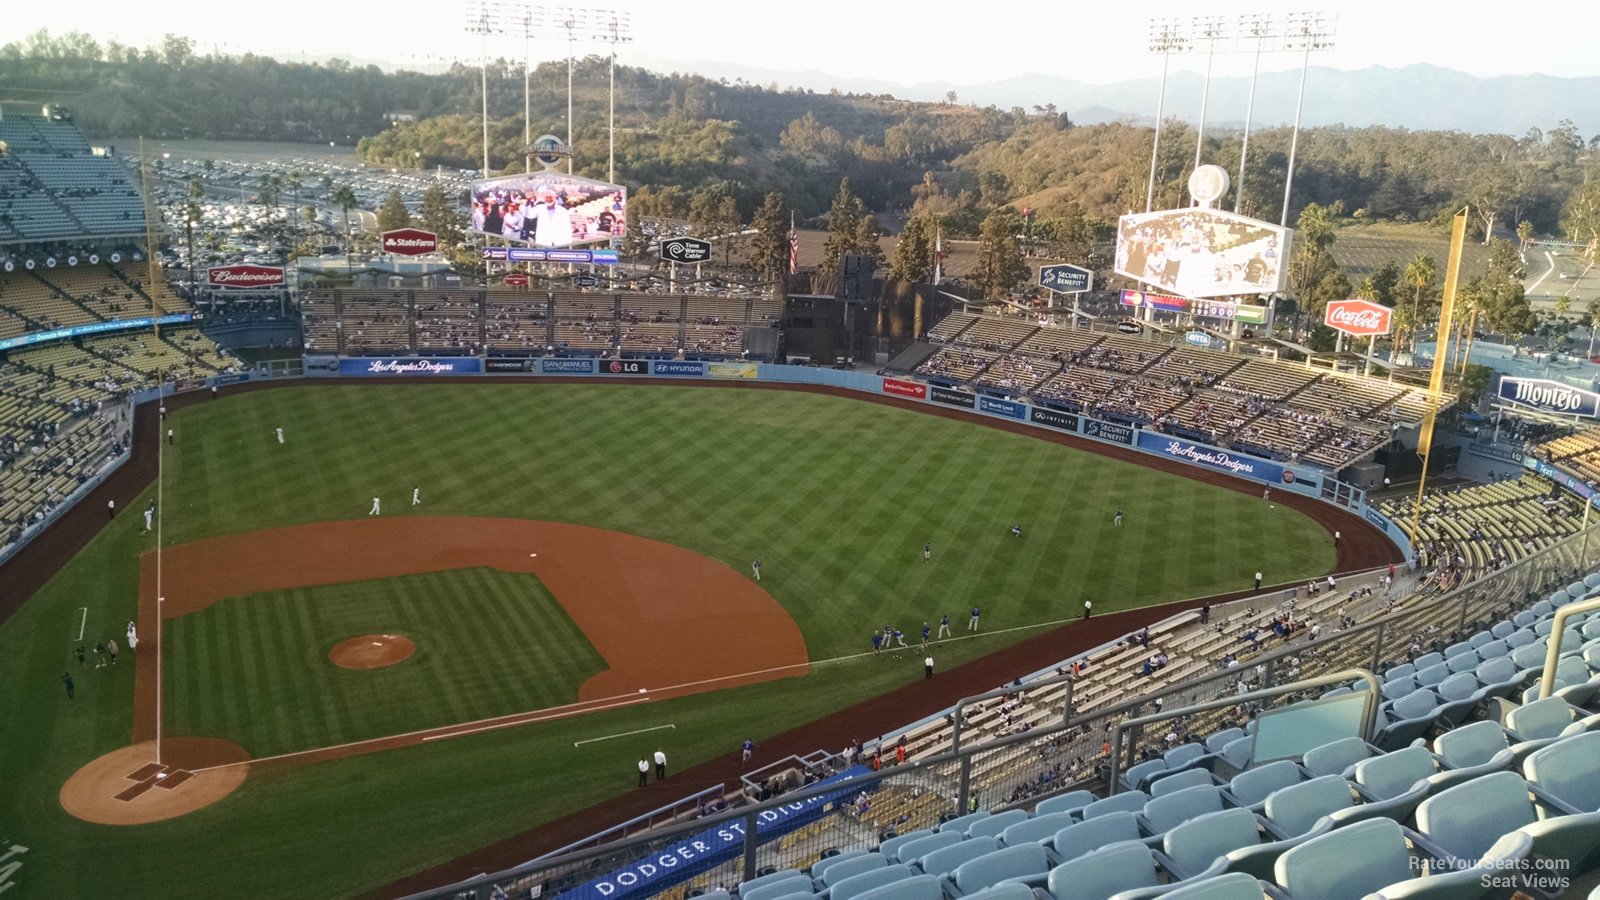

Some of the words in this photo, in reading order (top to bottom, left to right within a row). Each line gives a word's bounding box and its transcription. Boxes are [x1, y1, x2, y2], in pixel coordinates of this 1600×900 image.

[211, 270, 282, 282] Budweiser
[1058, 271, 1086, 280] SECURITY
[1057, 278, 1082, 286] BENEFIT
[384, 360, 418, 374] Angeles
[417, 360, 453, 373] Dodgers
[1516, 381, 1581, 411] Montejo
[1047, 415, 1075, 426] INFINITI
[1099, 430, 1126, 442] BENEFIT
[1101, 424, 1130, 436] SECURITY
[1165, 441, 1182, 454] Los
[1181, 446, 1215, 463] Angeles
[1215, 453, 1253, 473] Dodgers
[1540, 464, 1553, 476] Text
[596, 841, 710, 896] DODGER
